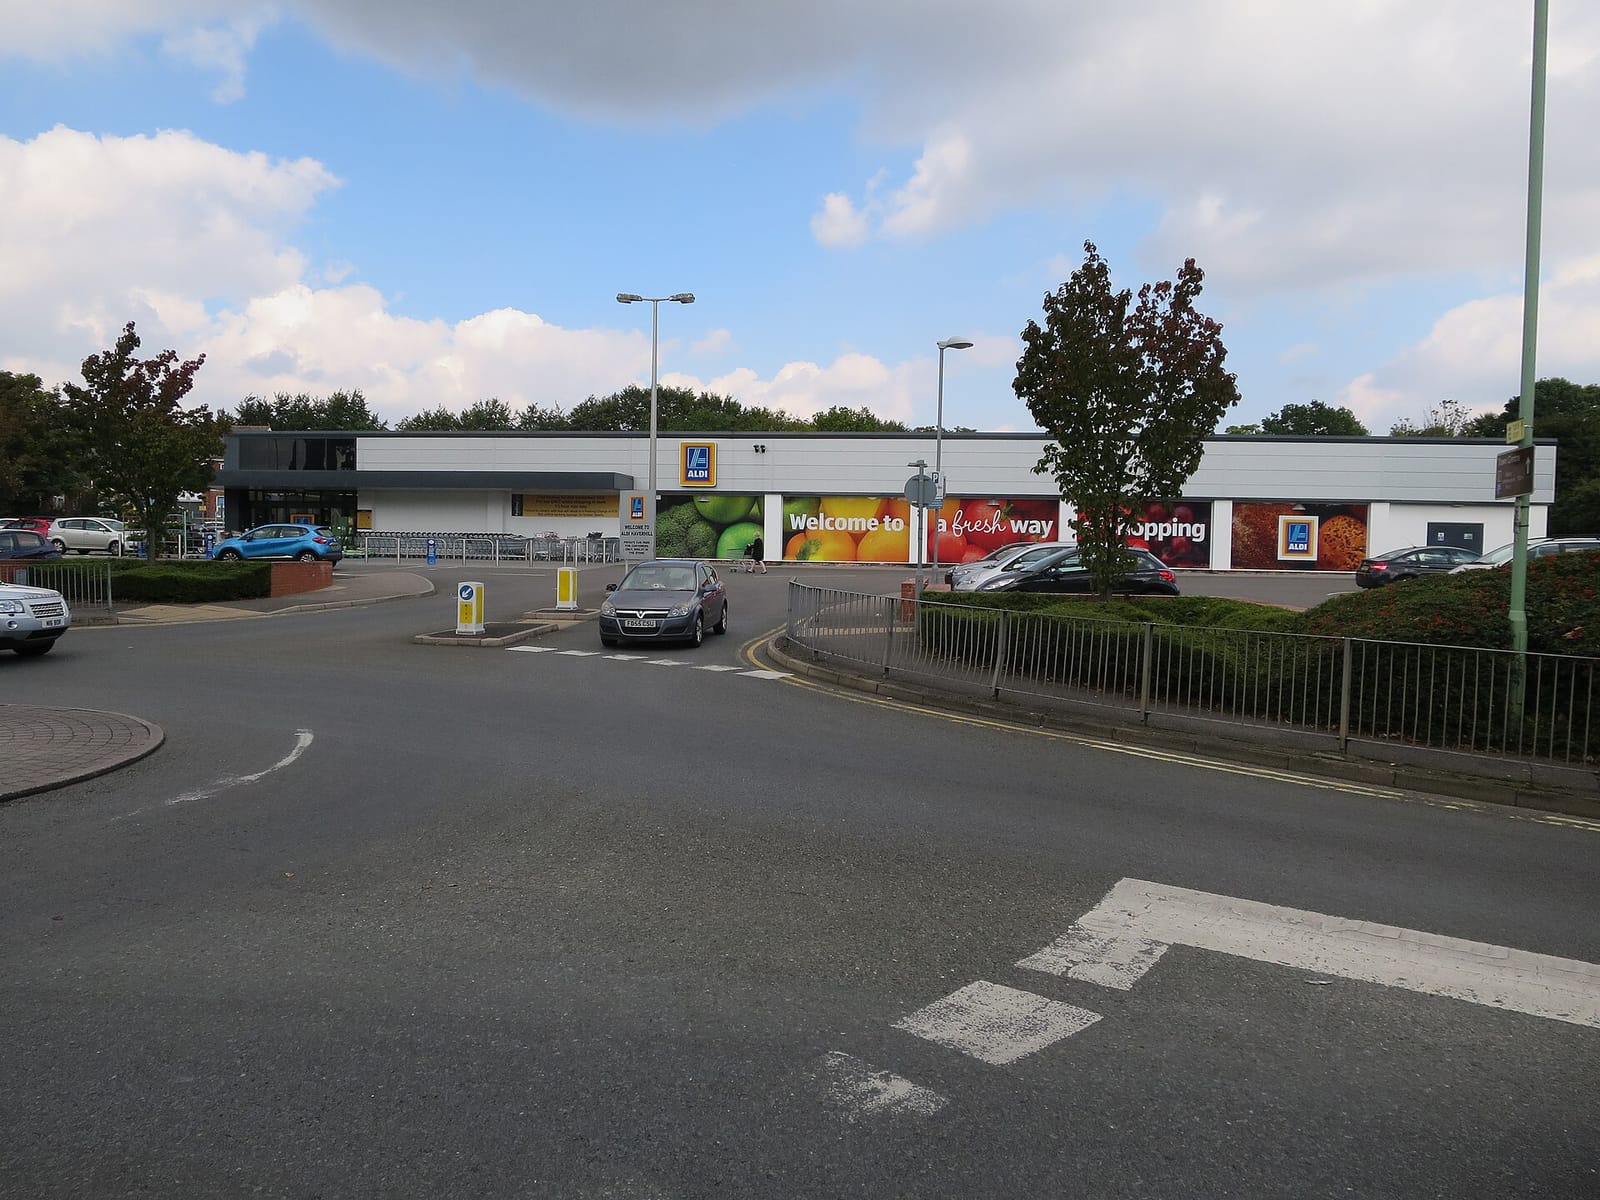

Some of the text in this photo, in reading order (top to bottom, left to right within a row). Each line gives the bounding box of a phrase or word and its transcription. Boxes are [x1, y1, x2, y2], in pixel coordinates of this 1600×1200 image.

[687, 470, 708, 478] ALDI
[789, 512, 879, 532] Welcome
[883, 515, 905, 532] to
[937, 518, 947, 533] a
[951, 509, 1007, 537] fresh
[1009, 519, 1054, 539] way
[1288, 543, 1307, 551] ALDI
